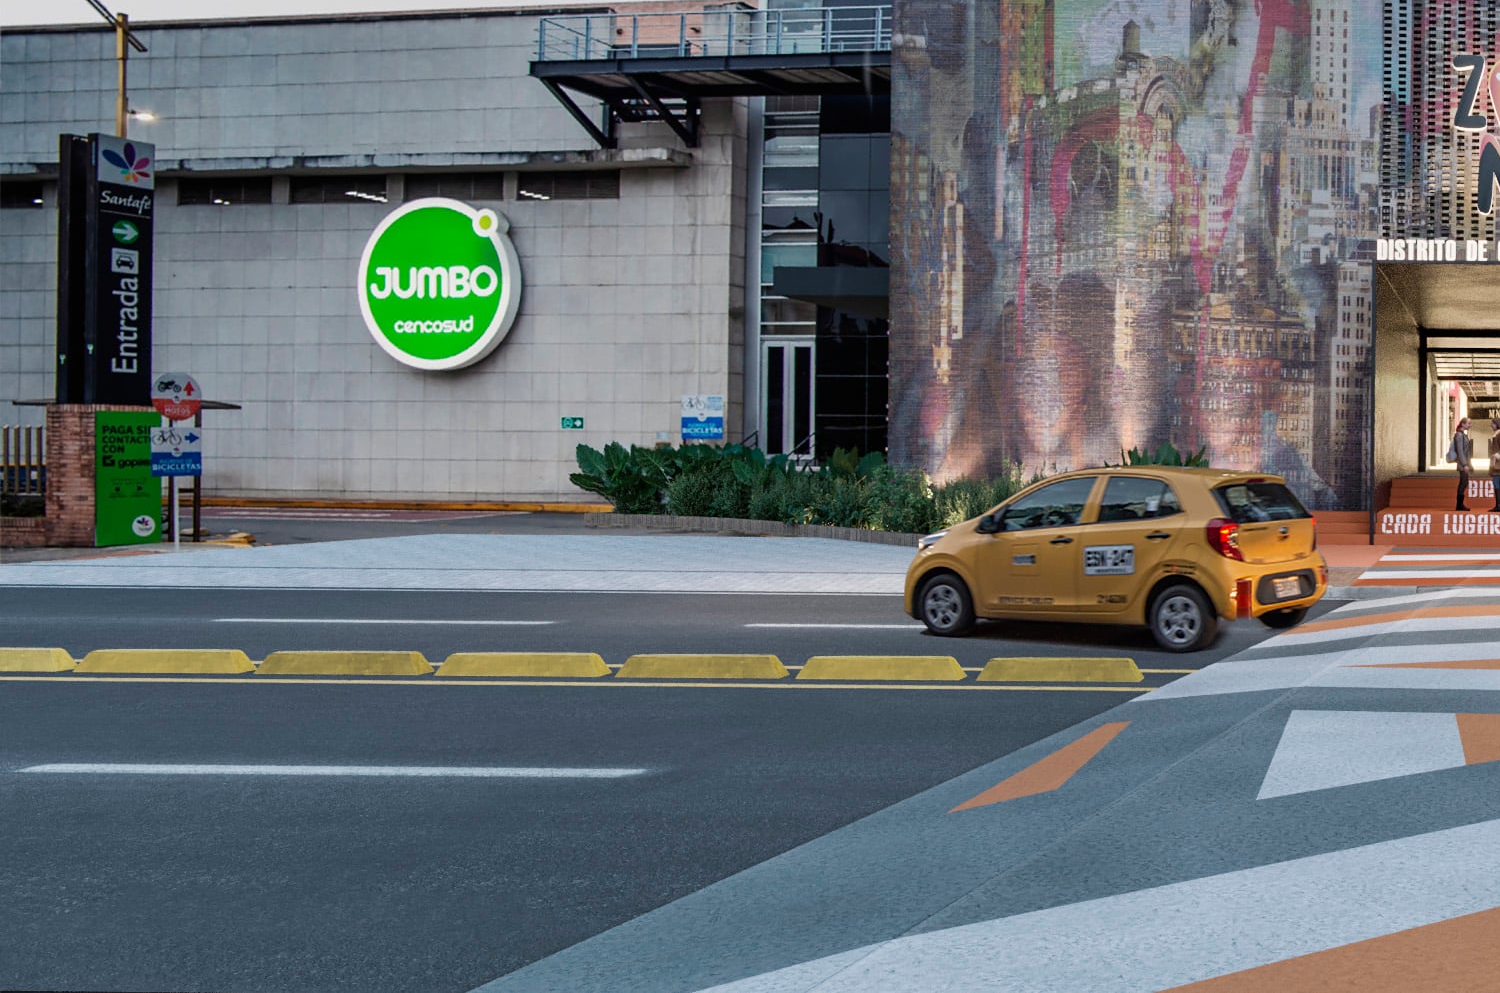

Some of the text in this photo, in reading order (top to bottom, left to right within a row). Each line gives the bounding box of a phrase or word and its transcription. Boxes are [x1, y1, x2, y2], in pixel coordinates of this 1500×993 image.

[100, 190, 151, 215] Santafé
[1376, 239, 1457, 261] DISTRITO
[1465, 239, 1489, 262] DE
[370, 265, 499, 299] JUMBO
[111, 276, 139, 374] Entrada
[394, 314, 474, 334] cencosud
[102, 425, 133, 435] PAGA
[102, 435, 151, 445] CONTACT
[102, 444, 125, 454] CON
[1381, 513, 1431, 535] CADA
